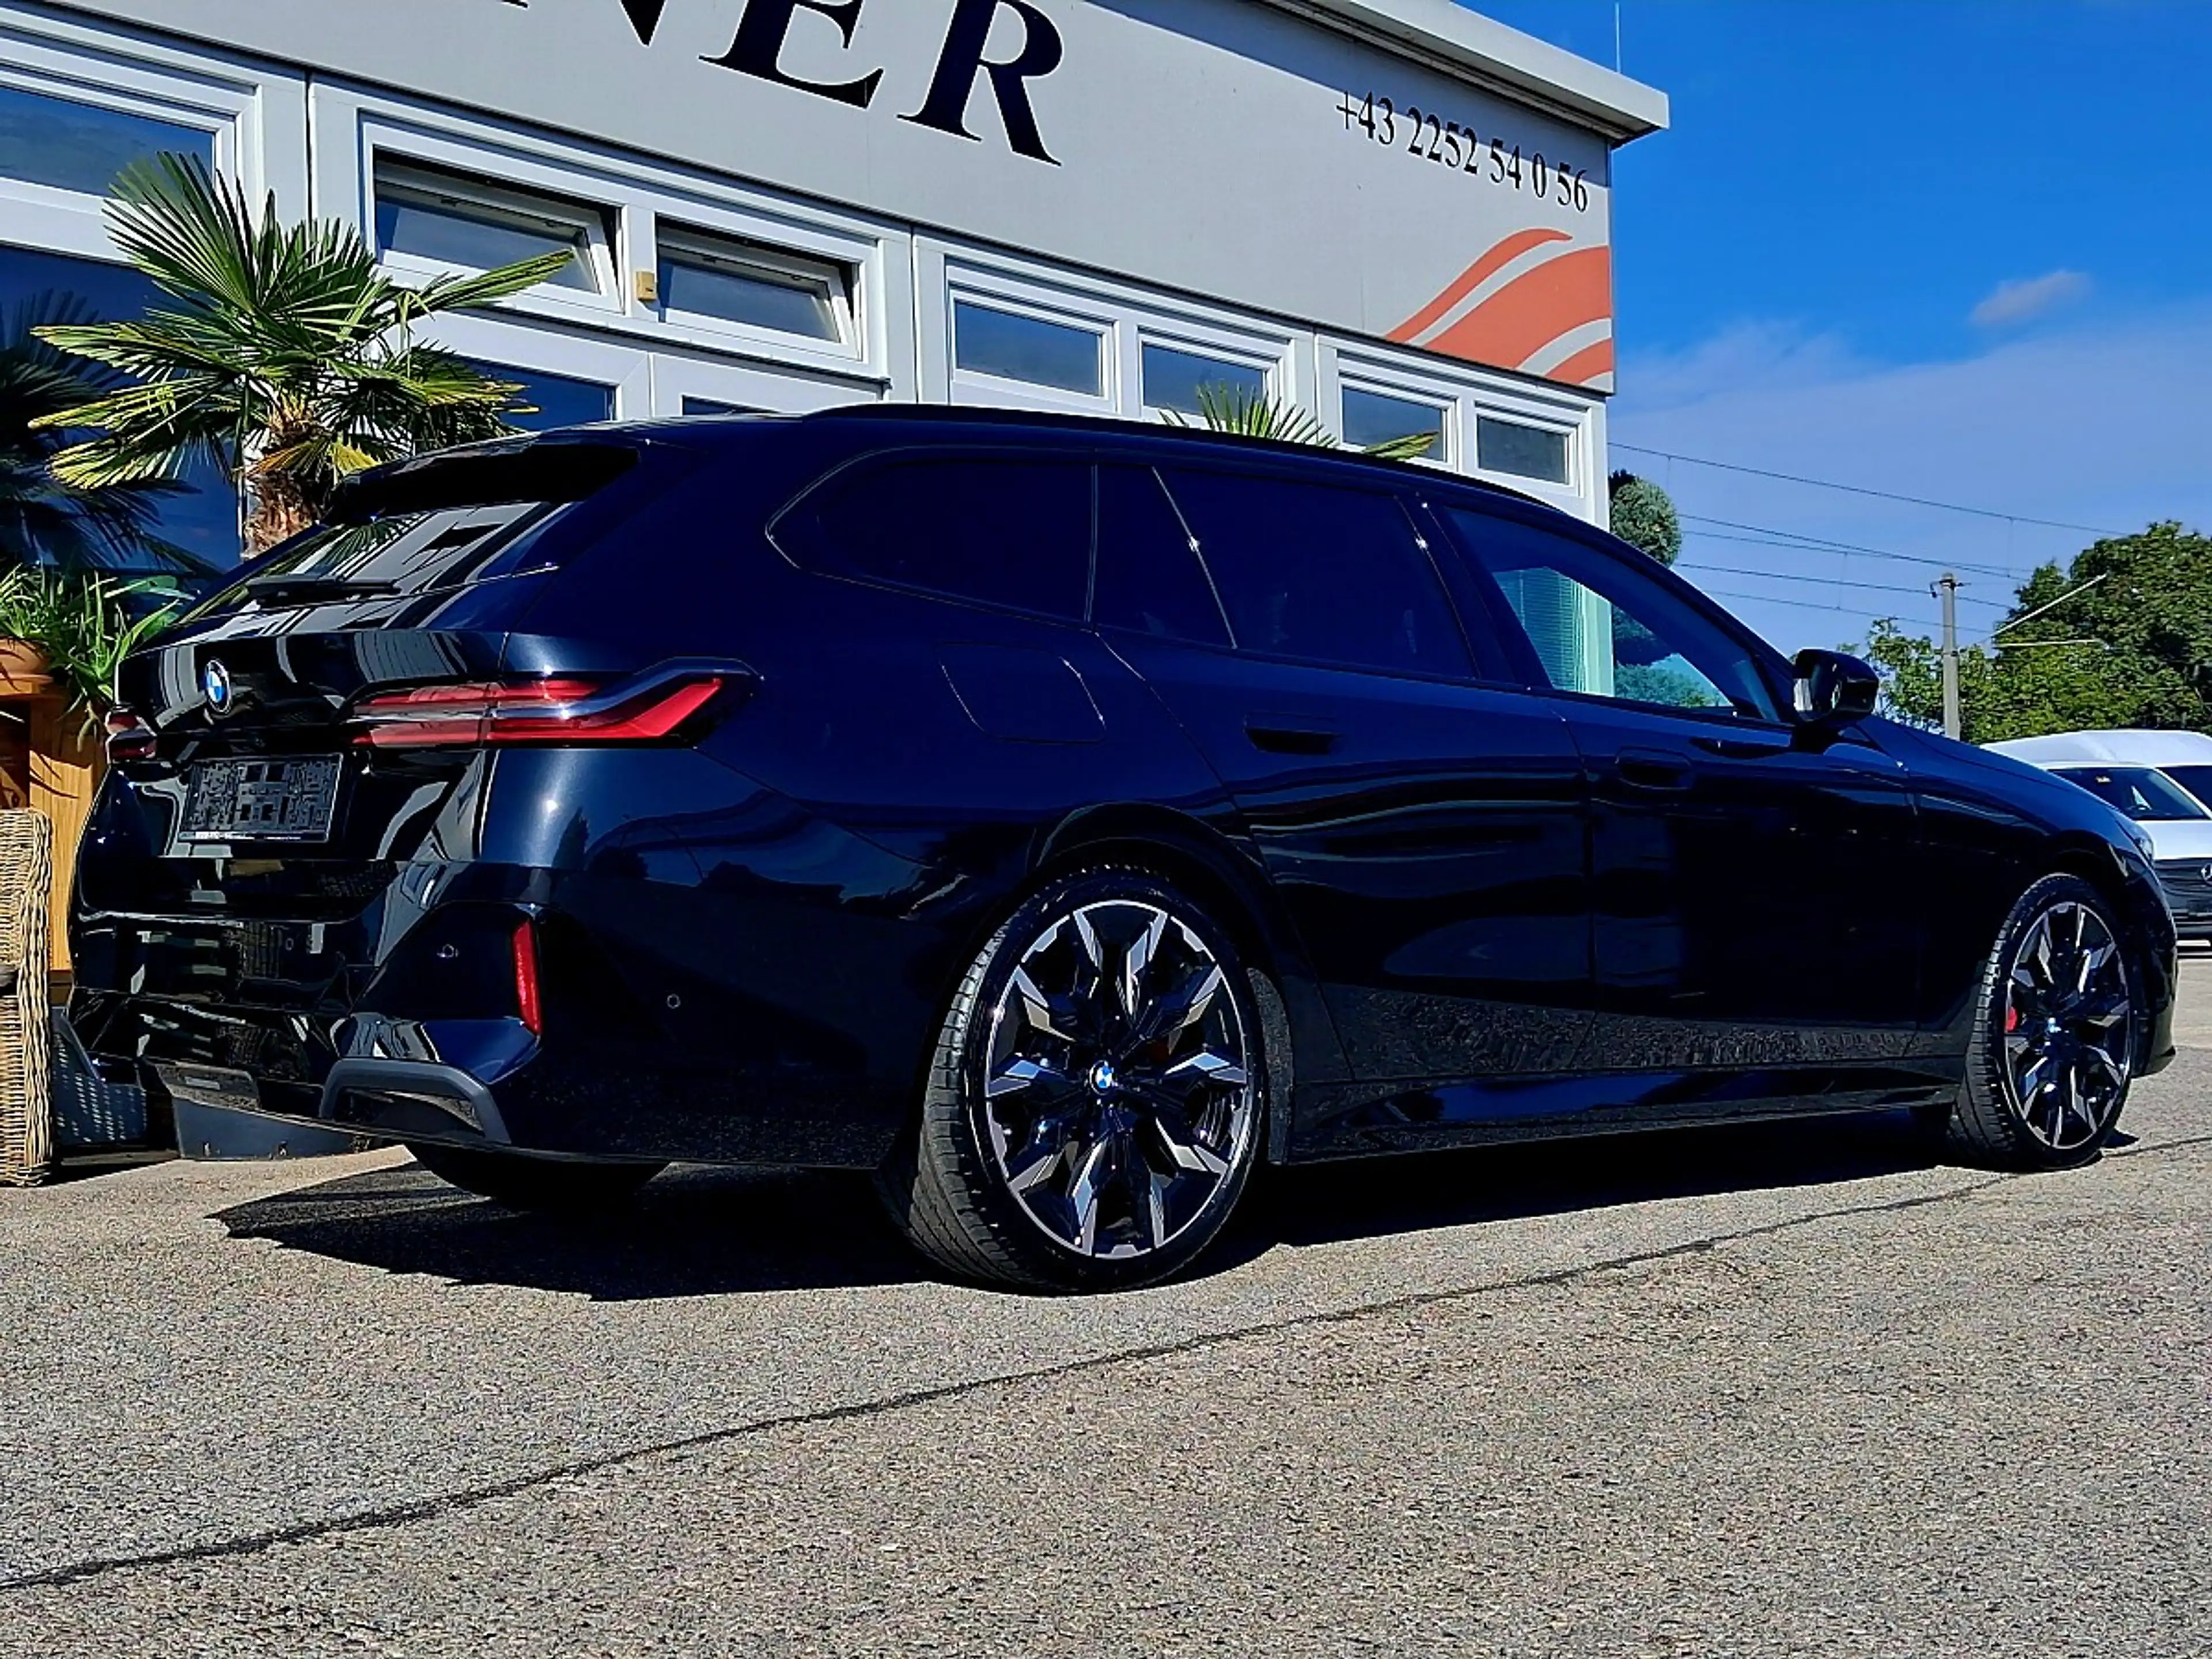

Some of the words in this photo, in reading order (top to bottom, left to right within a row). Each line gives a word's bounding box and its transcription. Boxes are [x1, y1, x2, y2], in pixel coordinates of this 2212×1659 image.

[1336, 91, 1395, 145] +43
[1407, 107, 1479, 175] 2252
[1489, 138, 1522, 190] 54
[1531, 152, 1547, 198] 0
[1556, 162, 1589, 213] 56
